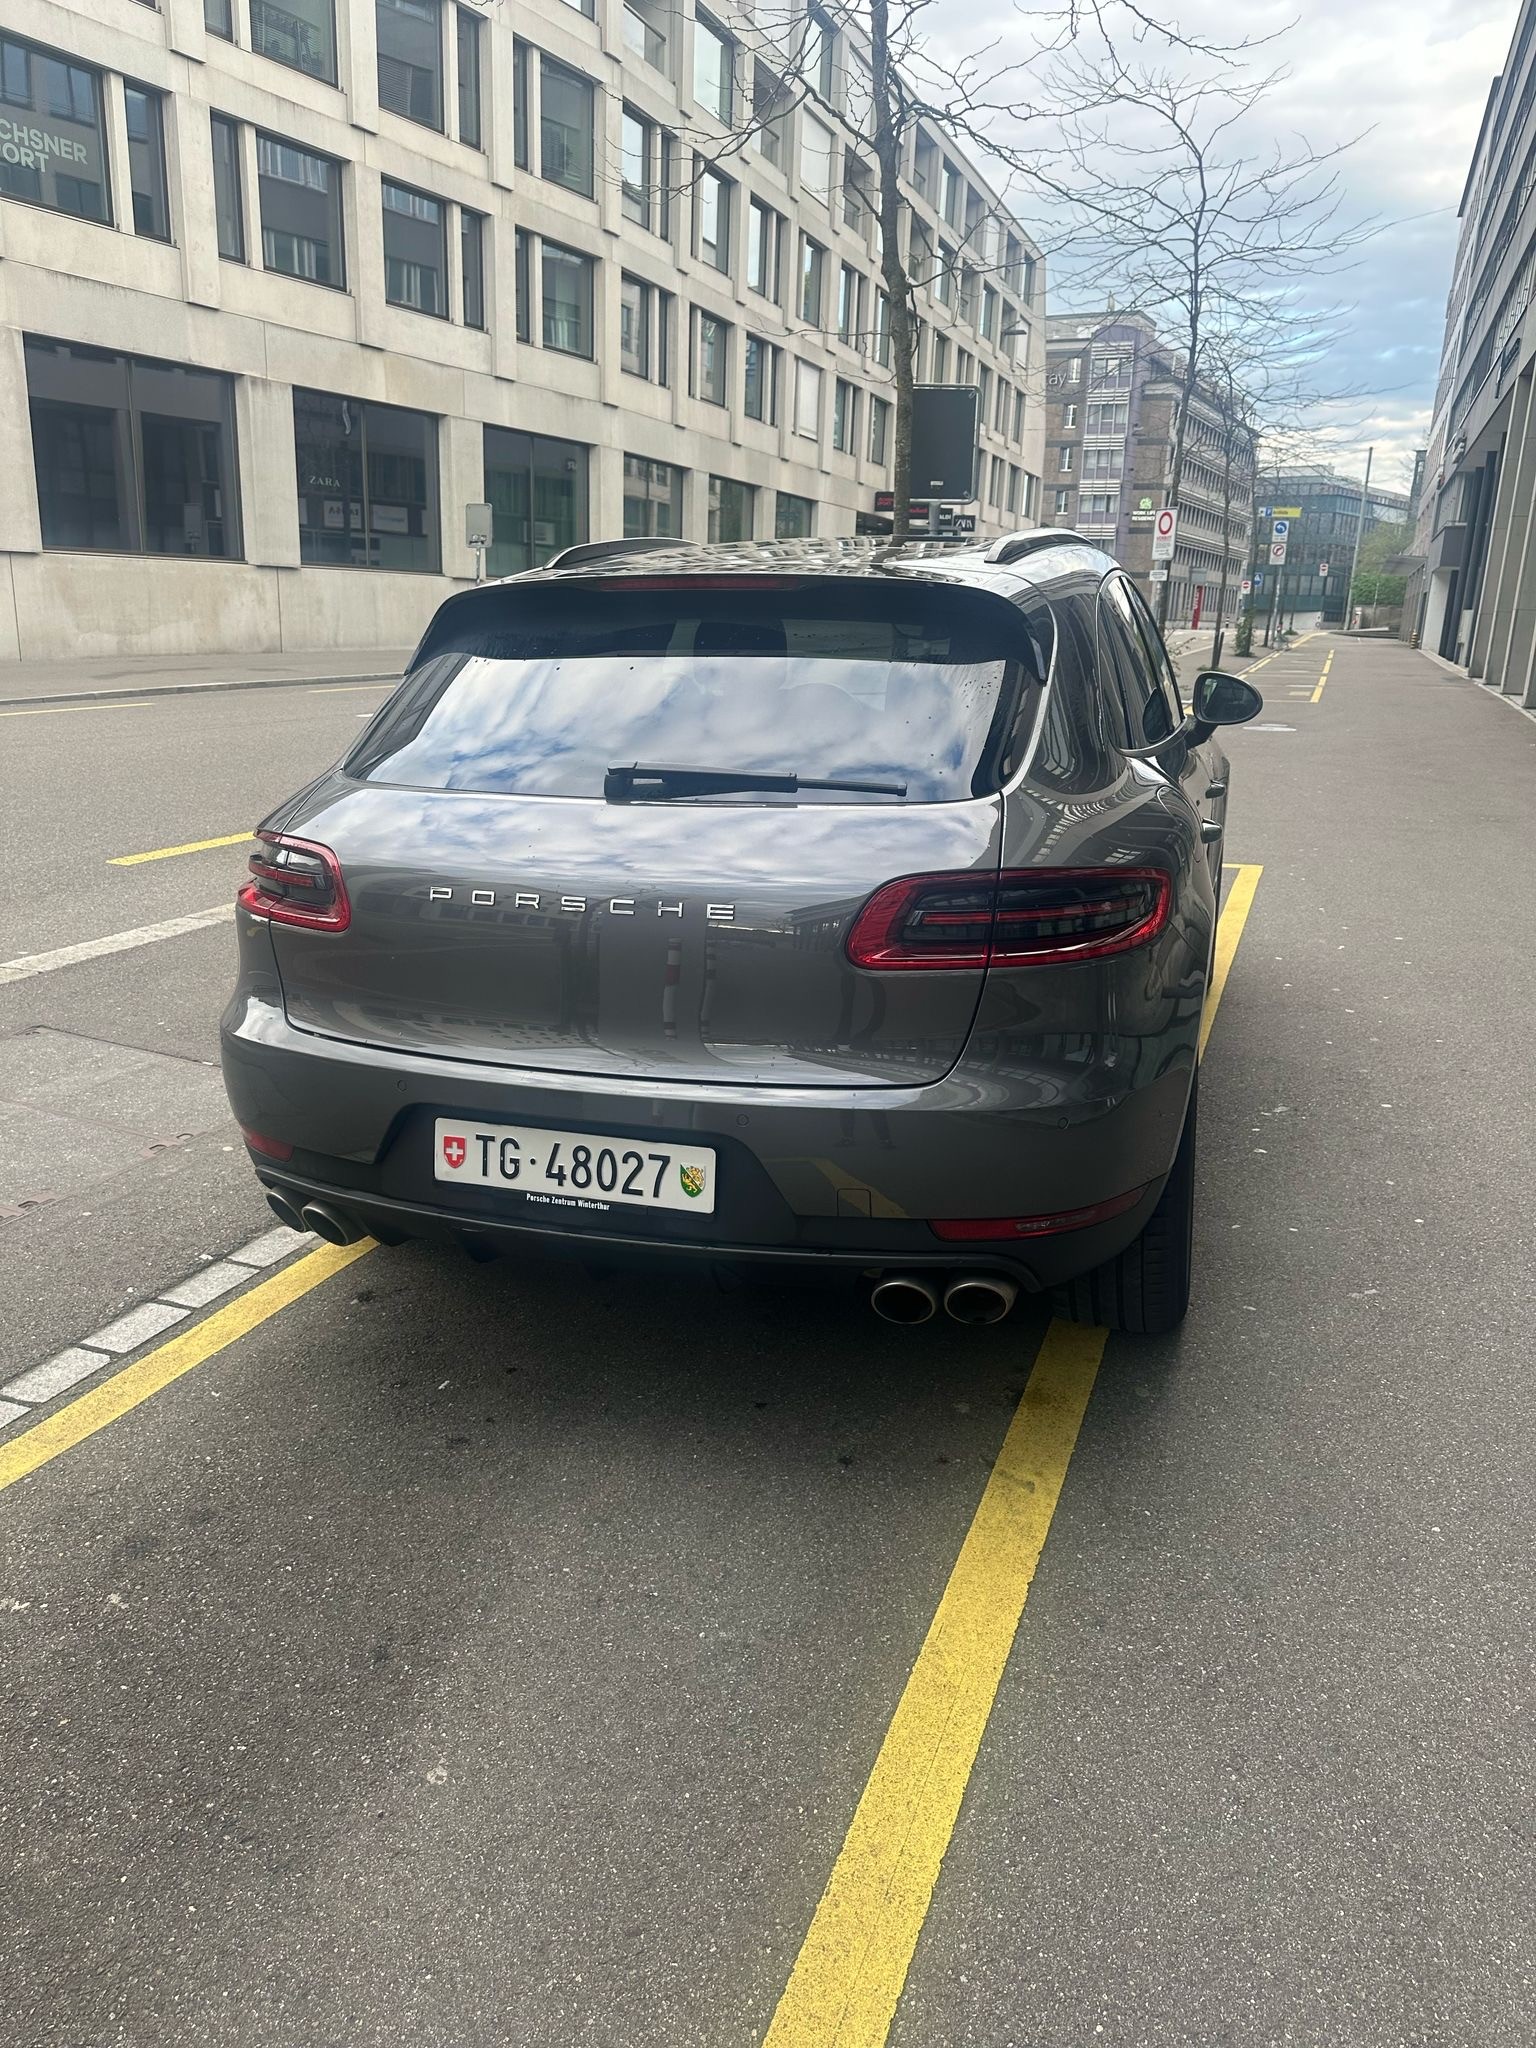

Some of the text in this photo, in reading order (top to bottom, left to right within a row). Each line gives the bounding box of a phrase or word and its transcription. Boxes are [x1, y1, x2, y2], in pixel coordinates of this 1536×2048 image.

[0, 142, 49, 173] ORT
[309, 475, 341, 487] ZARA
[430, 886, 735, 920] PORSCHE
[526, 1193, 610, 1211] Porsche Zentrum Winterthur
